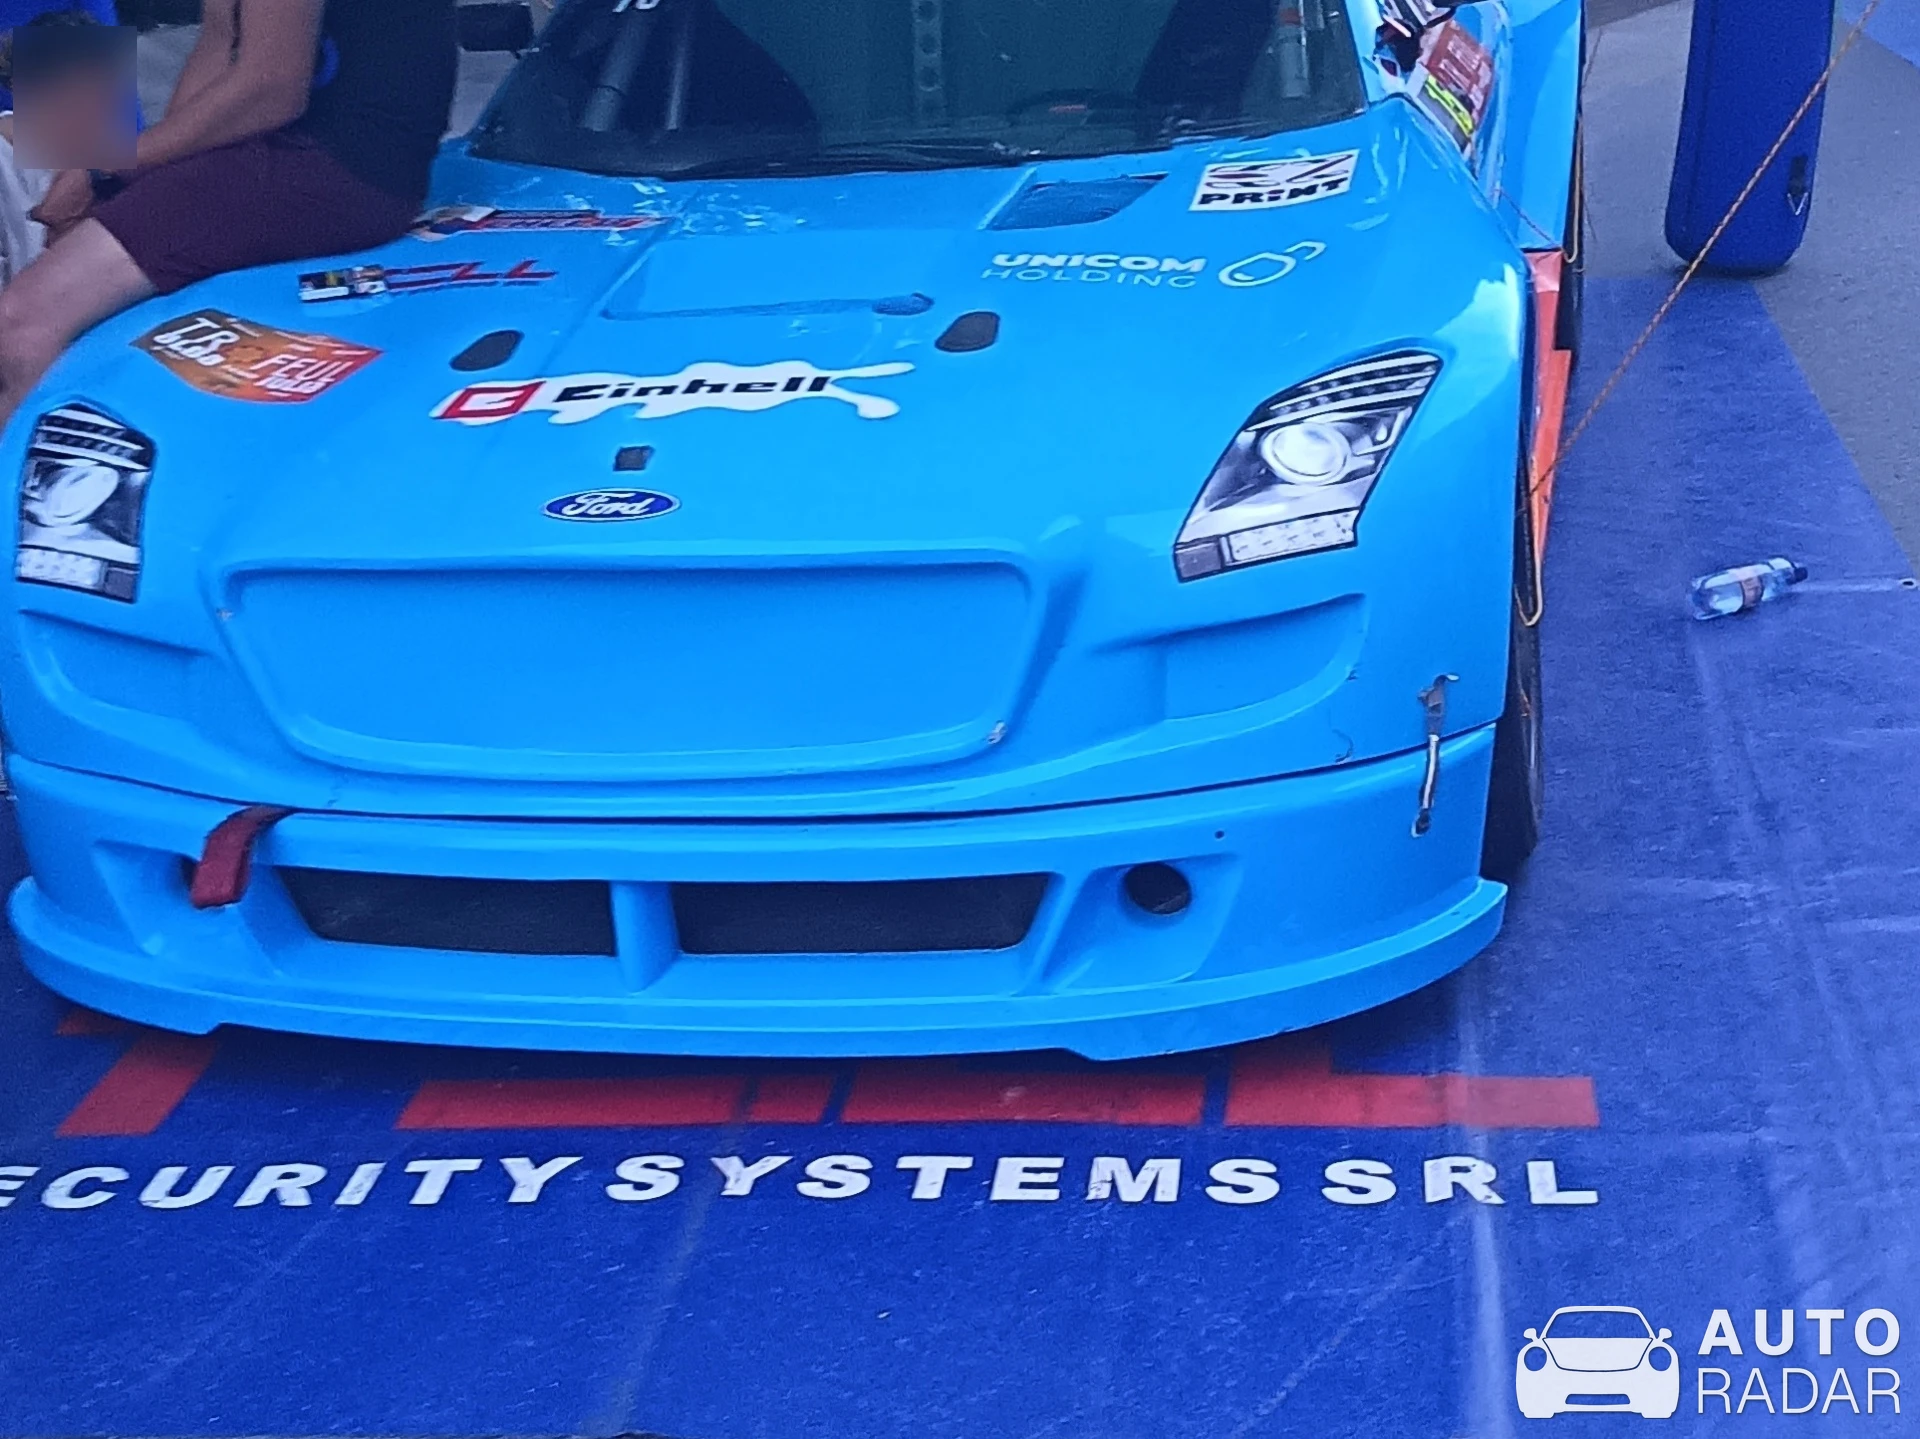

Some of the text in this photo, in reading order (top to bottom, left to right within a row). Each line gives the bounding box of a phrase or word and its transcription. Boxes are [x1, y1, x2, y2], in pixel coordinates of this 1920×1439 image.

[991, 253, 1207, 273] UNICOM
[980, 268, 1198, 288] HOLDING
[552, 376, 831, 404] Einhell
[560, 491, 656, 516] Ford
[604, 1154, 1281, 1205] SYSTEMS
[1321, 1155, 1599, 1206] SRL
